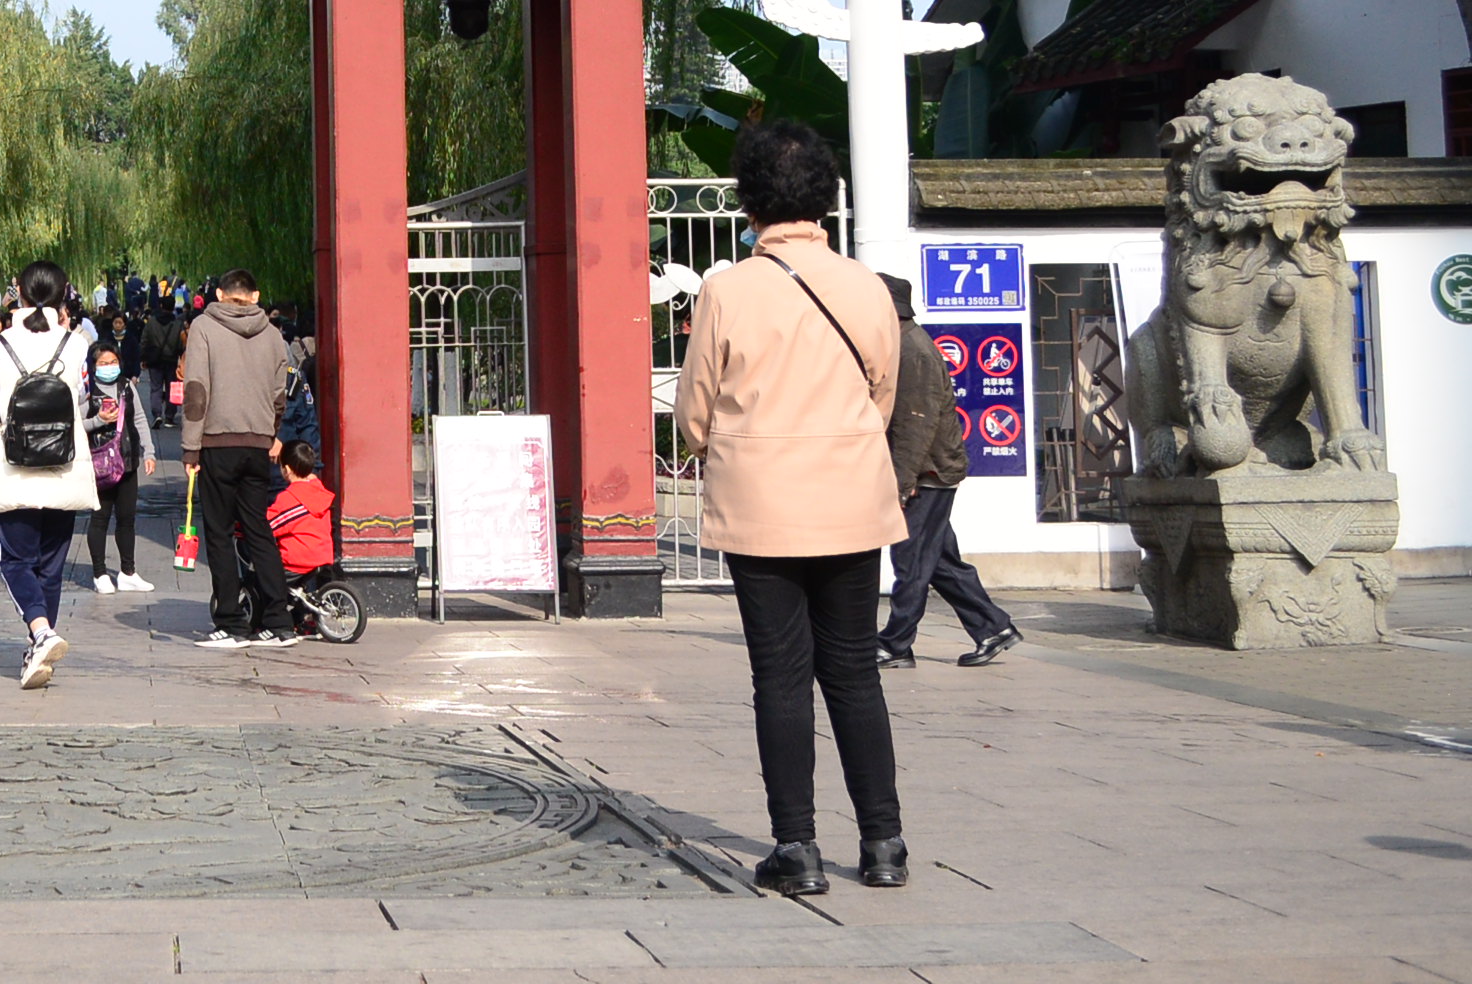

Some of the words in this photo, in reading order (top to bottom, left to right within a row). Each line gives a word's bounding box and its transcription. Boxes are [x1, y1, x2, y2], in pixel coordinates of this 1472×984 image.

[937, 249, 1007, 261] 湖滨路
[949, 263, 991, 294] 71
[936, 296, 966, 306] 邮政编码
[967, 296, 1000, 305] 350025
[982, 387, 1014, 396] 禁止入内
[982, 446, 1018, 456] 严禁烟火
